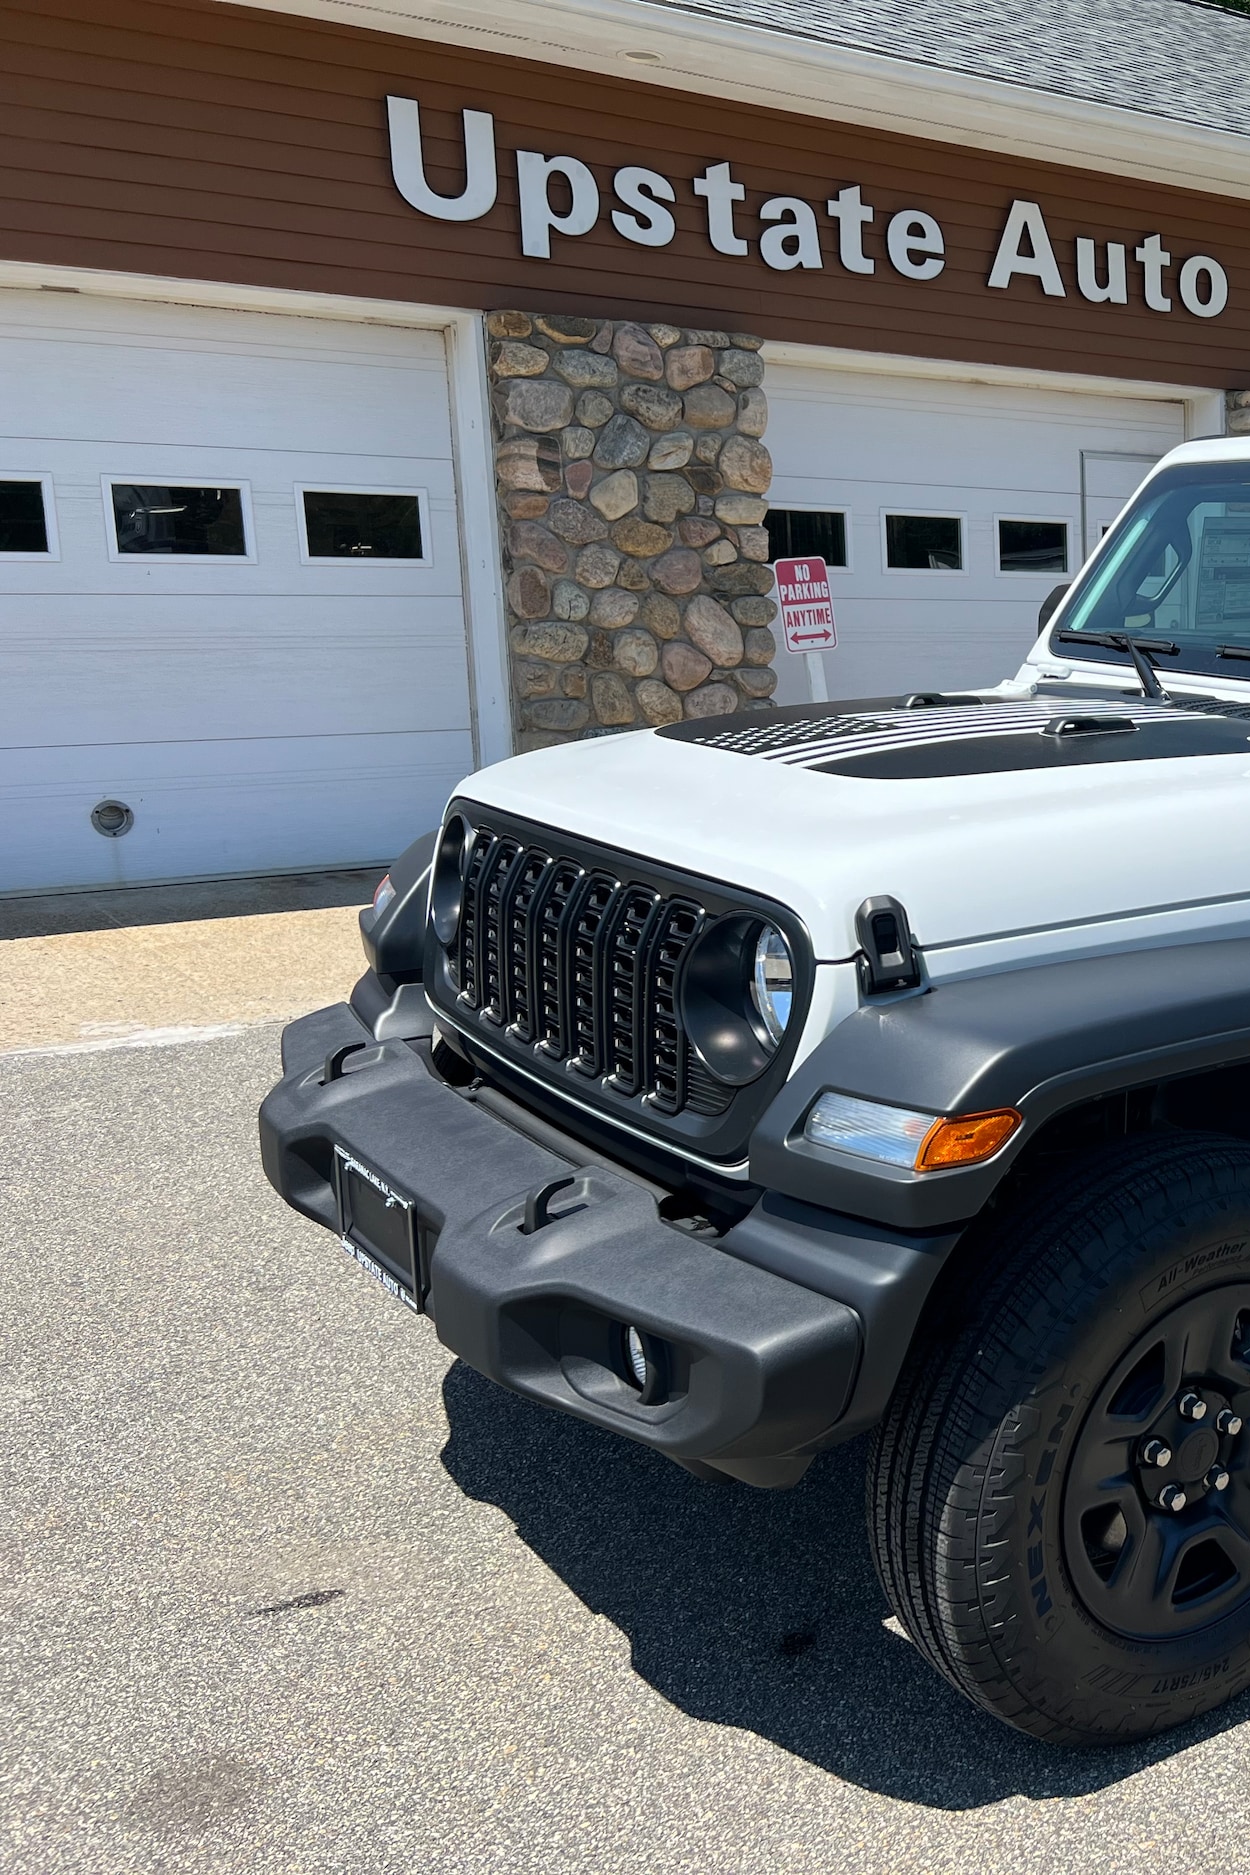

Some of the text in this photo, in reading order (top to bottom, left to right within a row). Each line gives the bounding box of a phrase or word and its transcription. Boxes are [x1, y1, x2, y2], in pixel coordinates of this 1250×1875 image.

[386, 94, 1230, 319] Upstate Auto
[794, 563, 811, 582] NO
[779, 581, 830, 602] PARKING
[786, 607, 832, 628] ANYTIME
[1157, 1241, 1248, 1293] All-Weather
[383, 1273, 399, 1296] AUTO
[1027, 1403, 1075, 1619] NEXEN
[1150, 1656, 1231, 1695] 245/75R17
